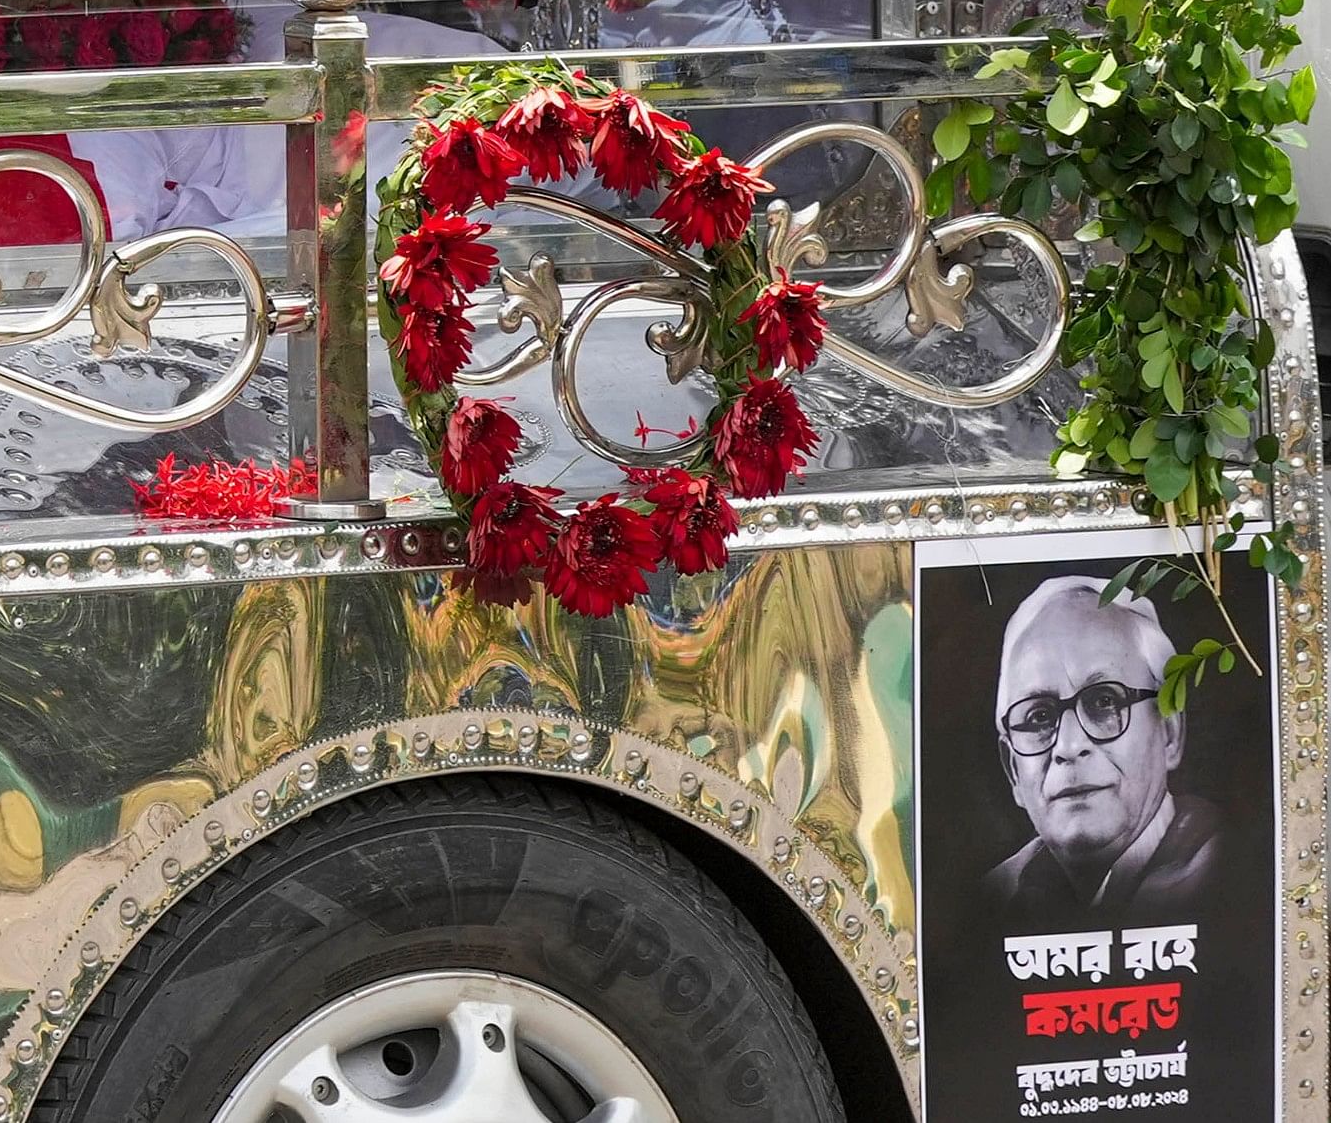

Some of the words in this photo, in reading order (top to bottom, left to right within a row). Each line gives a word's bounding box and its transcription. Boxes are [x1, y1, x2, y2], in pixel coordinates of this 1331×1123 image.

[1004, 930, 1113, 984] অমর
[1122, 924, 1198, 981] রহে
[1022, 982, 1181, 1041] কমরেড
[1016, 1060, 1099, 1102] বুদ্ধদেব
[1103, 1040, 1187, 1088] ভট্টাচার্য
[1020, 1088, 1189, 1117] ০১.০৩.১৯৪৪-০৮.০৮.২০২৪
